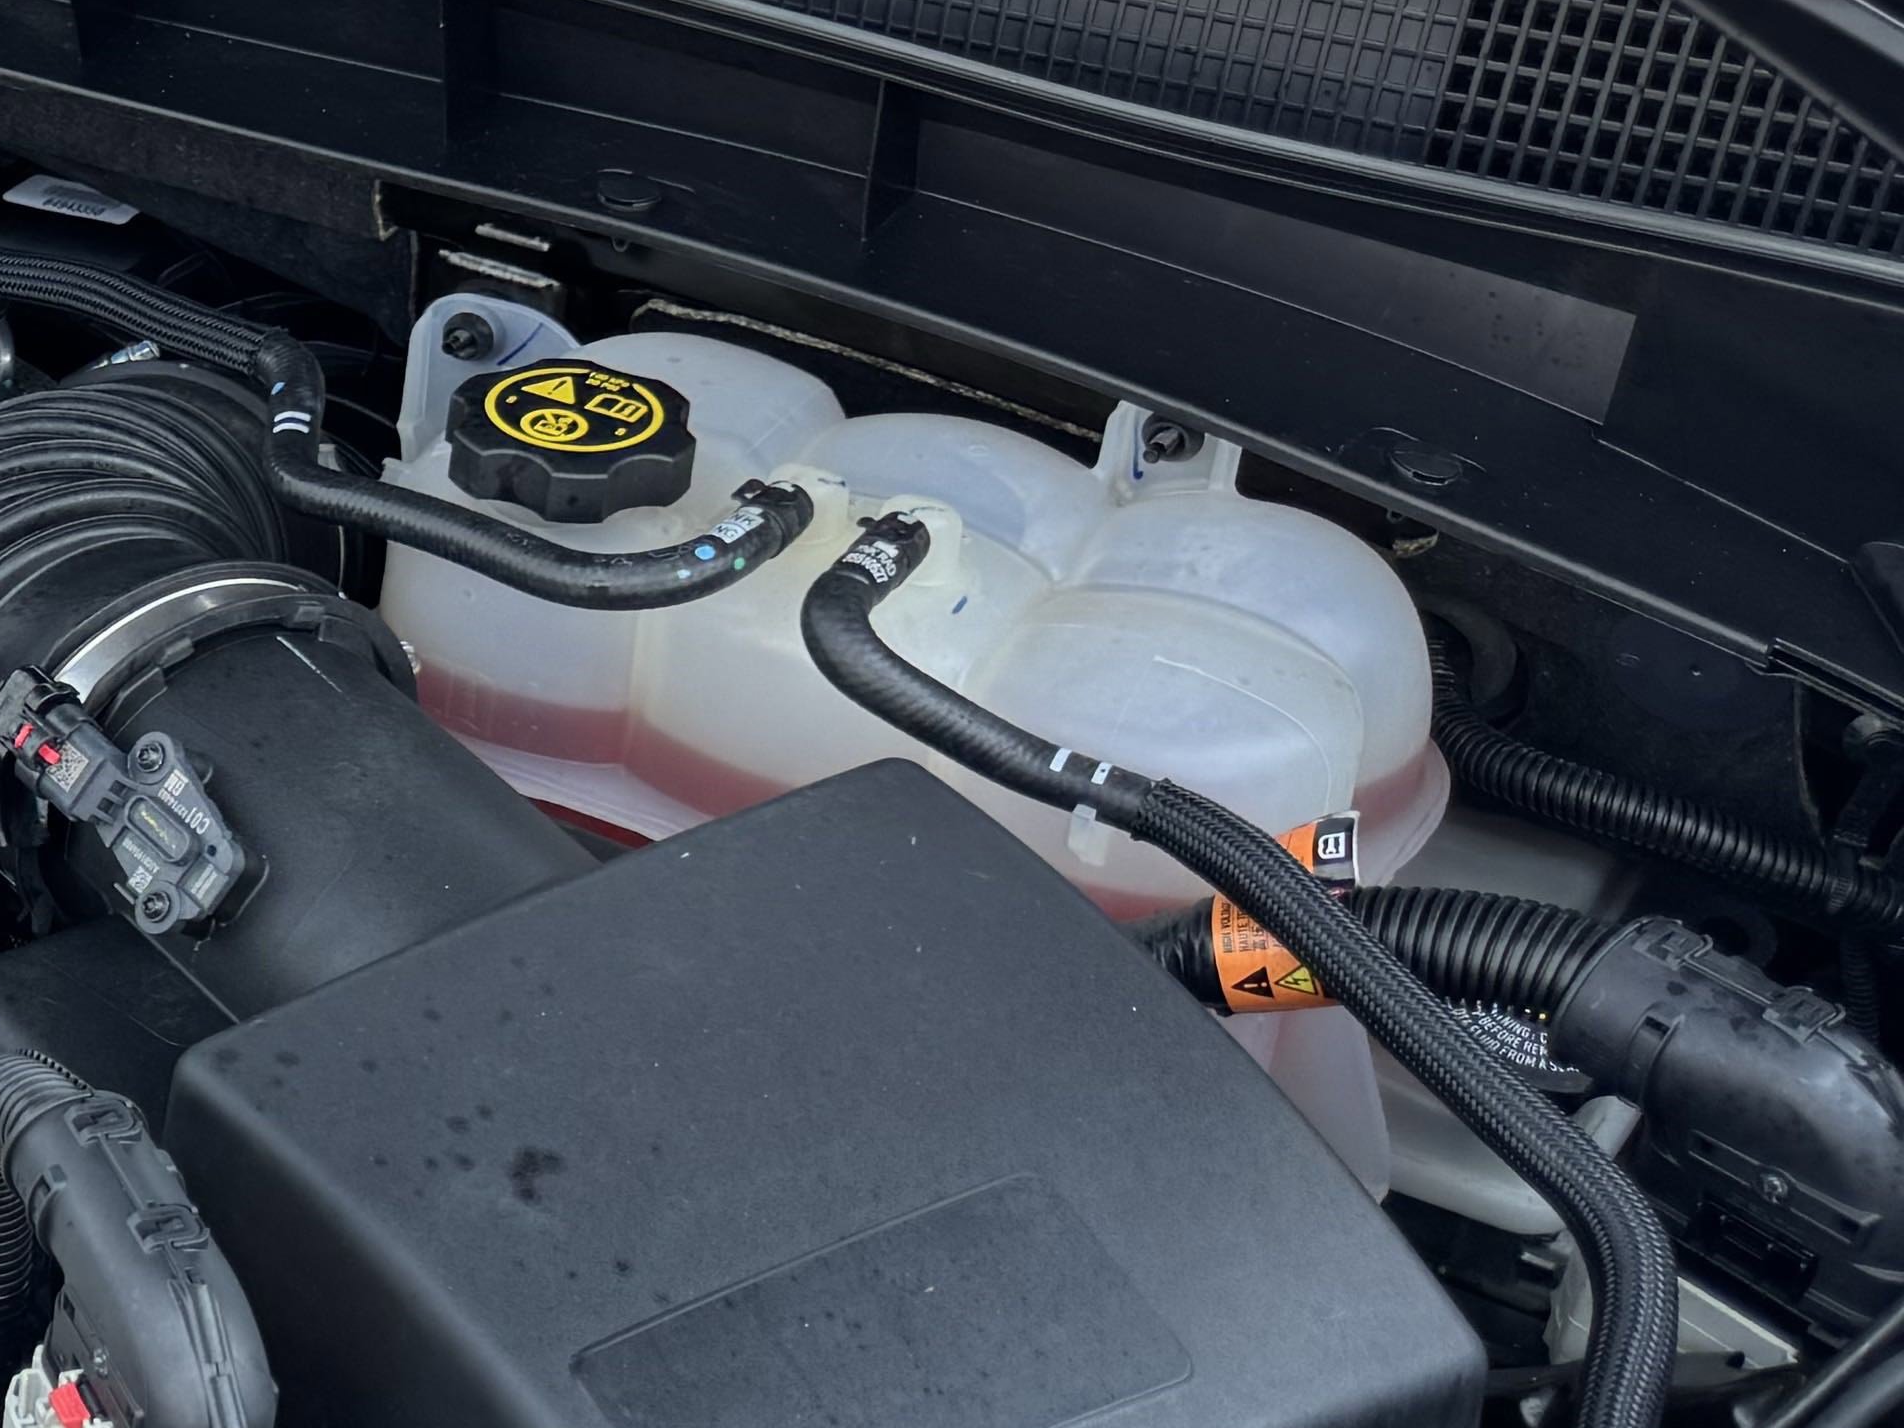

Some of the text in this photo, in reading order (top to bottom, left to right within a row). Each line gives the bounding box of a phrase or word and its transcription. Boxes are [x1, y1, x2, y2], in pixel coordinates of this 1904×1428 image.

[1469, 1024, 1501, 1052] FLUID
[1499, 1047, 1536, 1069] FROM
[1478, 1015, 1522, 1049] BEFORE
